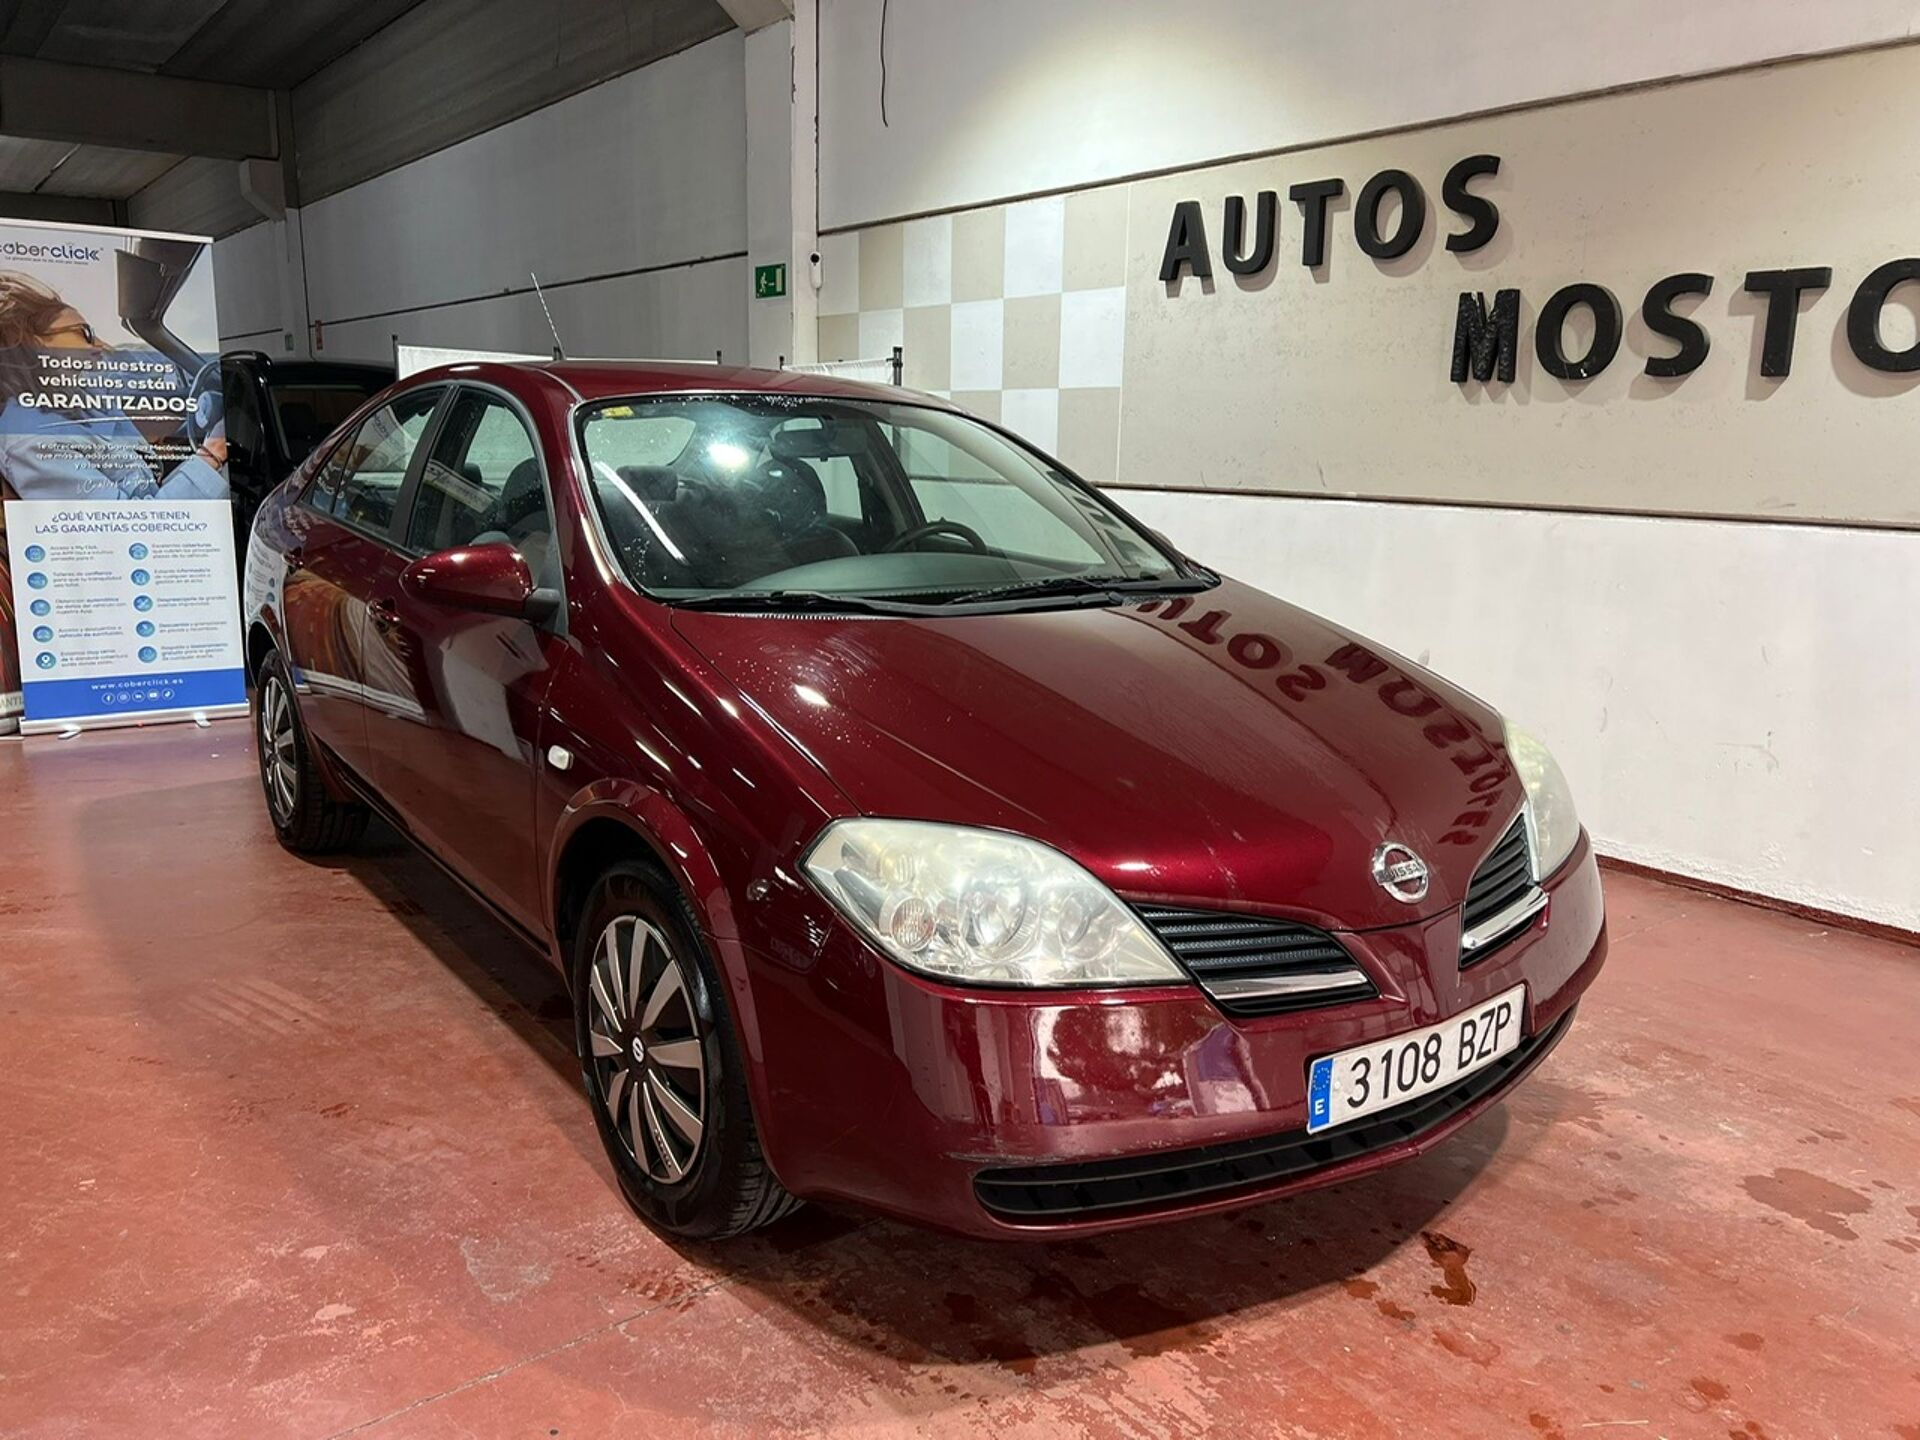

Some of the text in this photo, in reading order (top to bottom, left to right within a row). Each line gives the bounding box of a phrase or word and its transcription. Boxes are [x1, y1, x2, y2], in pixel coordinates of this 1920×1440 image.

[1159, 154, 1500, 281] AUTOS
[0, 241, 100, 261] oberclick
[1449, 257, 1920, 383] MOSTO
[38, 354, 174, 373] Todos nuestros
[39, 374, 177, 391] vehículos están
[18, 392, 199, 413] GARANTIZADOS
[52, 511, 190, 523] ¿QUÉ VENTAJAS TIENEN
[35, 523, 208, 534] LAS GARANTÍAS COBERCLICK?
[91, 678, 184, 691] www.coberclick.es
[1314, 1001, 1512, 1115] E 3108 BZP
